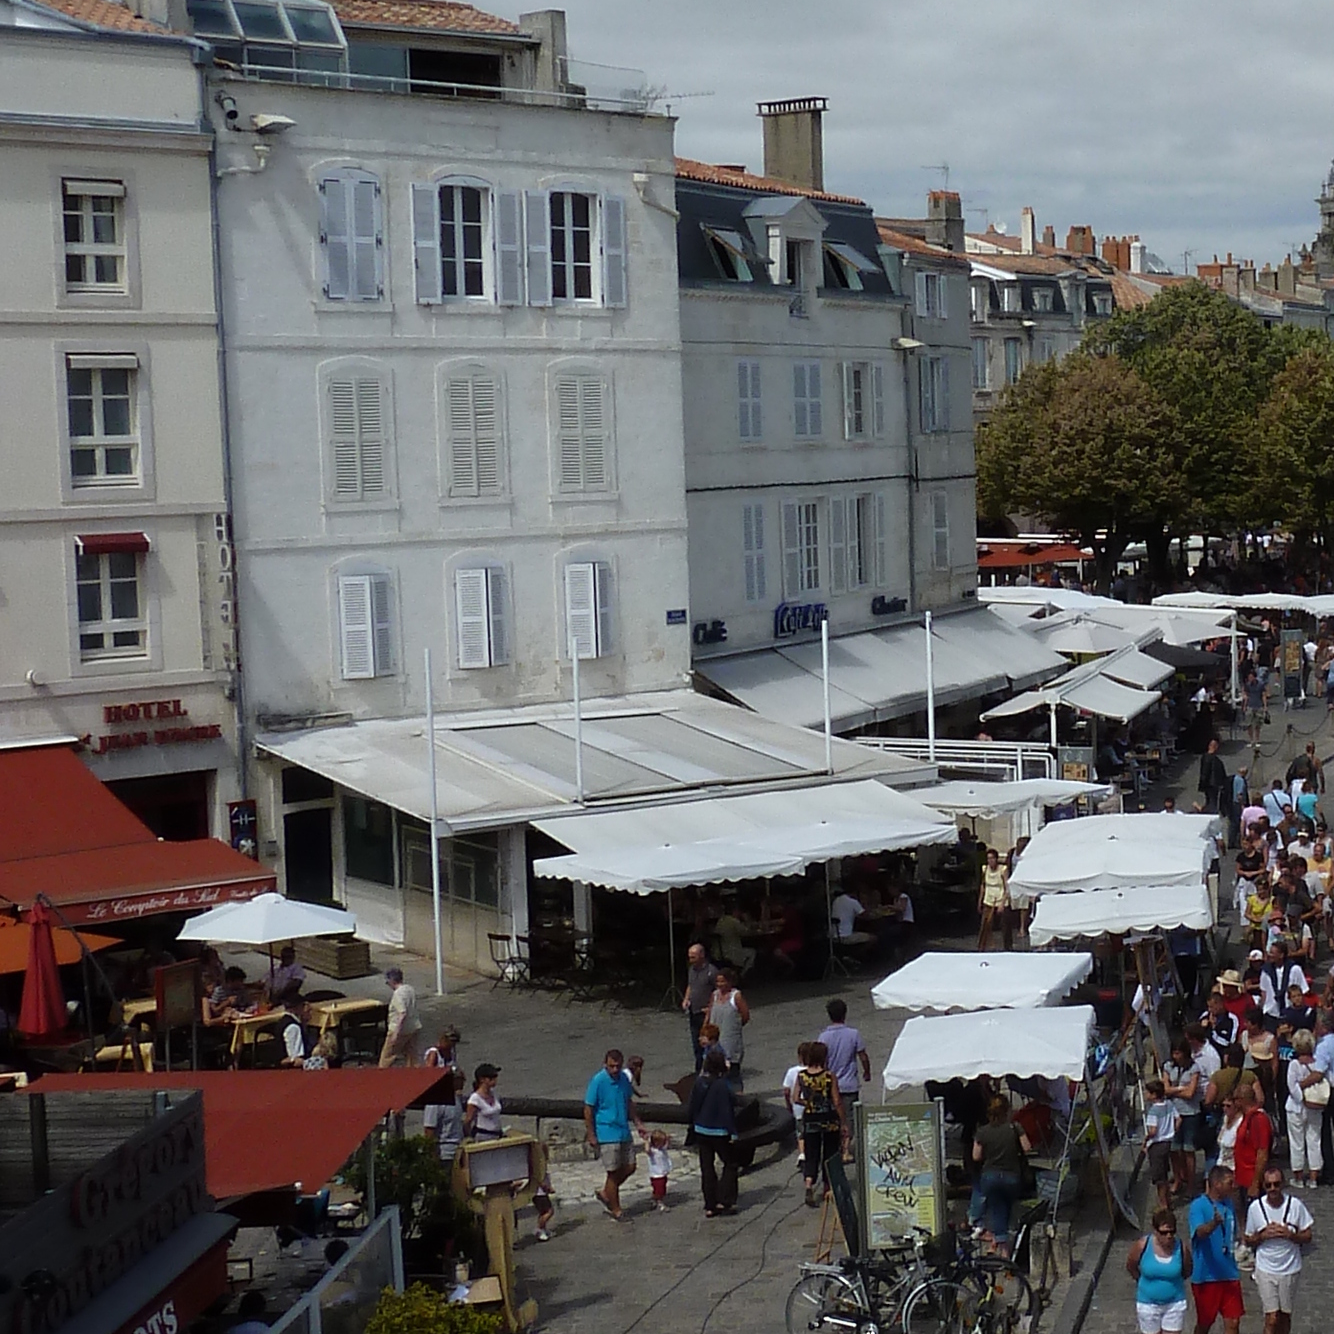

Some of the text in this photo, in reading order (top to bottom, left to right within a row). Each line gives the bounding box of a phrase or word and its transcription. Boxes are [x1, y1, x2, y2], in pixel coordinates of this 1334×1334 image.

[104, 700, 188, 723] HOTEL
[87, 902, 108, 918] Le
[111, 896, 170, 916] Comptoir
[173, 892, 190, 905] du
